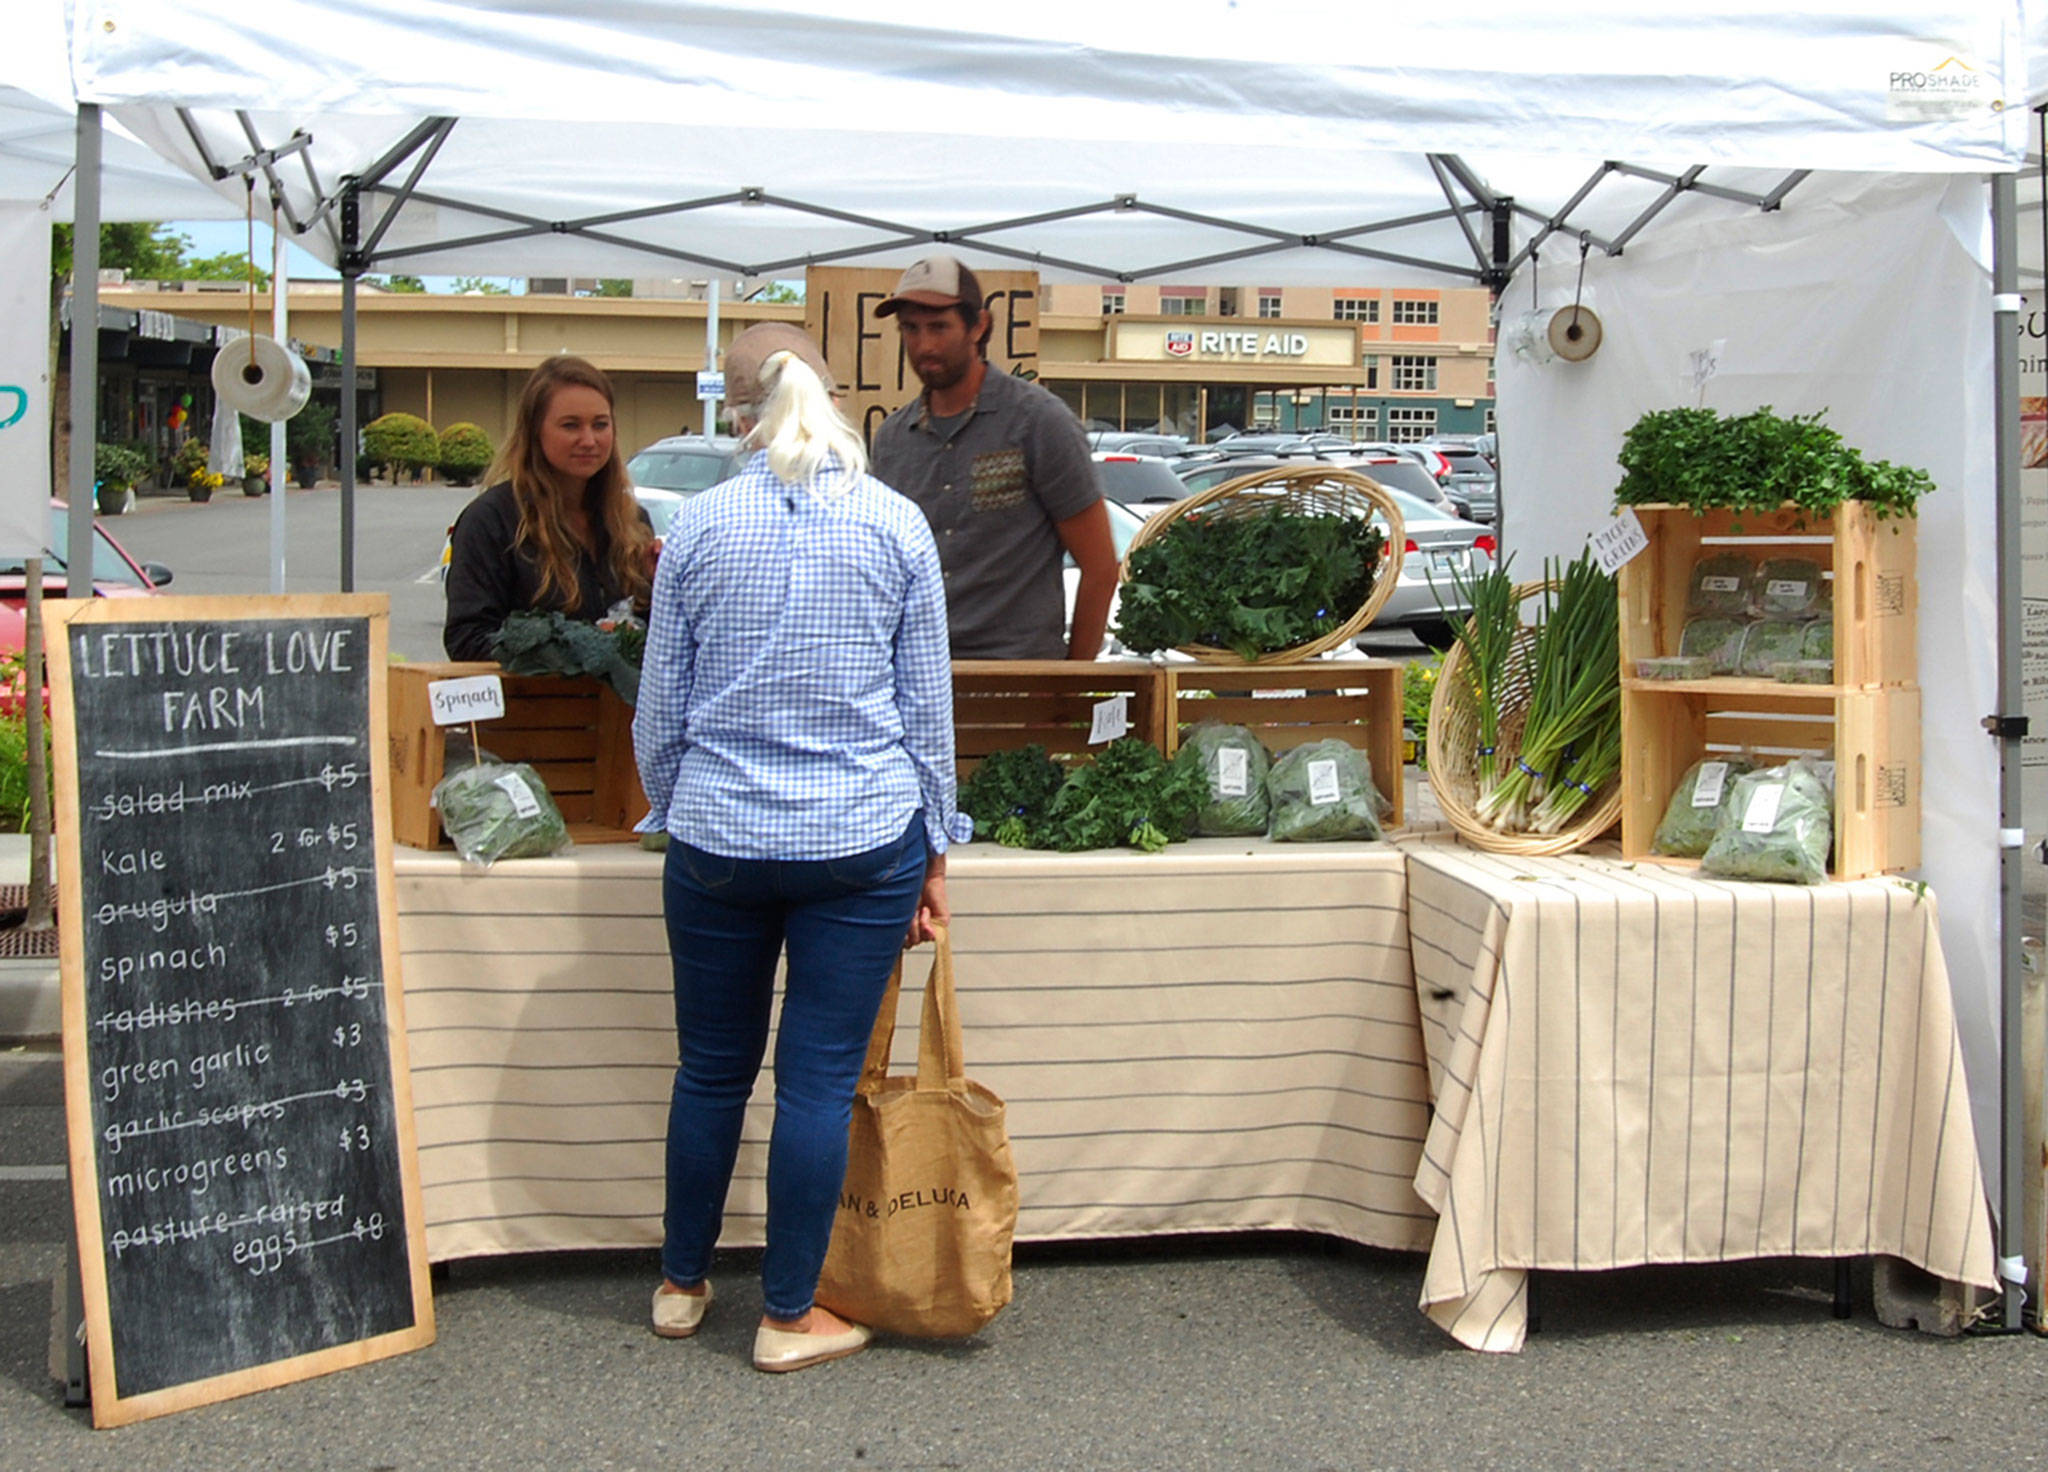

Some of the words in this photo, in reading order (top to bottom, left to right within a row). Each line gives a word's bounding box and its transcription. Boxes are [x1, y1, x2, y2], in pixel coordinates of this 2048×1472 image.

[1889, 71, 1981, 89] PROSHADE
[1201, 331, 1258, 354] RITE
[1263, 333, 1309, 355] AID
[80, 632, 240, 678] LETTUCE
[265, 630, 353, 675] LOVE
[163, 685, 265, 732] FARM
[99, 781, 186, 821] salad
[203, 780, 253, 805] mix
[320, 762, 358, 793] $5
[101, 848, 168, 876] Kale
[270, 832, 286, 854] 2
[297, 828, 322, 848] for
[326, 822, 358, 850] $5
[98, 889, 217, 932] arugula
[322, 865, 358, 890] $5
[100, 942, 226, 984] spinach
[324, 922, 358, 948] $5
[100, 996, 236, 1034] radishes
[283, 988, 295, 1008] 2
[306, 984, 333, 1004] for
[340, 975, 369, 999] $5
[101, 1058, 179, 1102] green
[189, 1044, 271, 1089] garlic
[332, 1023, 363, 1048] $3
[104, 1110, 183, 1154] garlic
[199, 1102, 286, 1129] scapes
[335, 1078, 367, 1102] $3
[107, 1146, 289, 1197] microgreens
[338, 1124, 371, 1152] $3
[866, 1200, 879, 1219] &
[232, 1230, 297, 1276] eggs
[352, 1212, 384, 1243] $8
